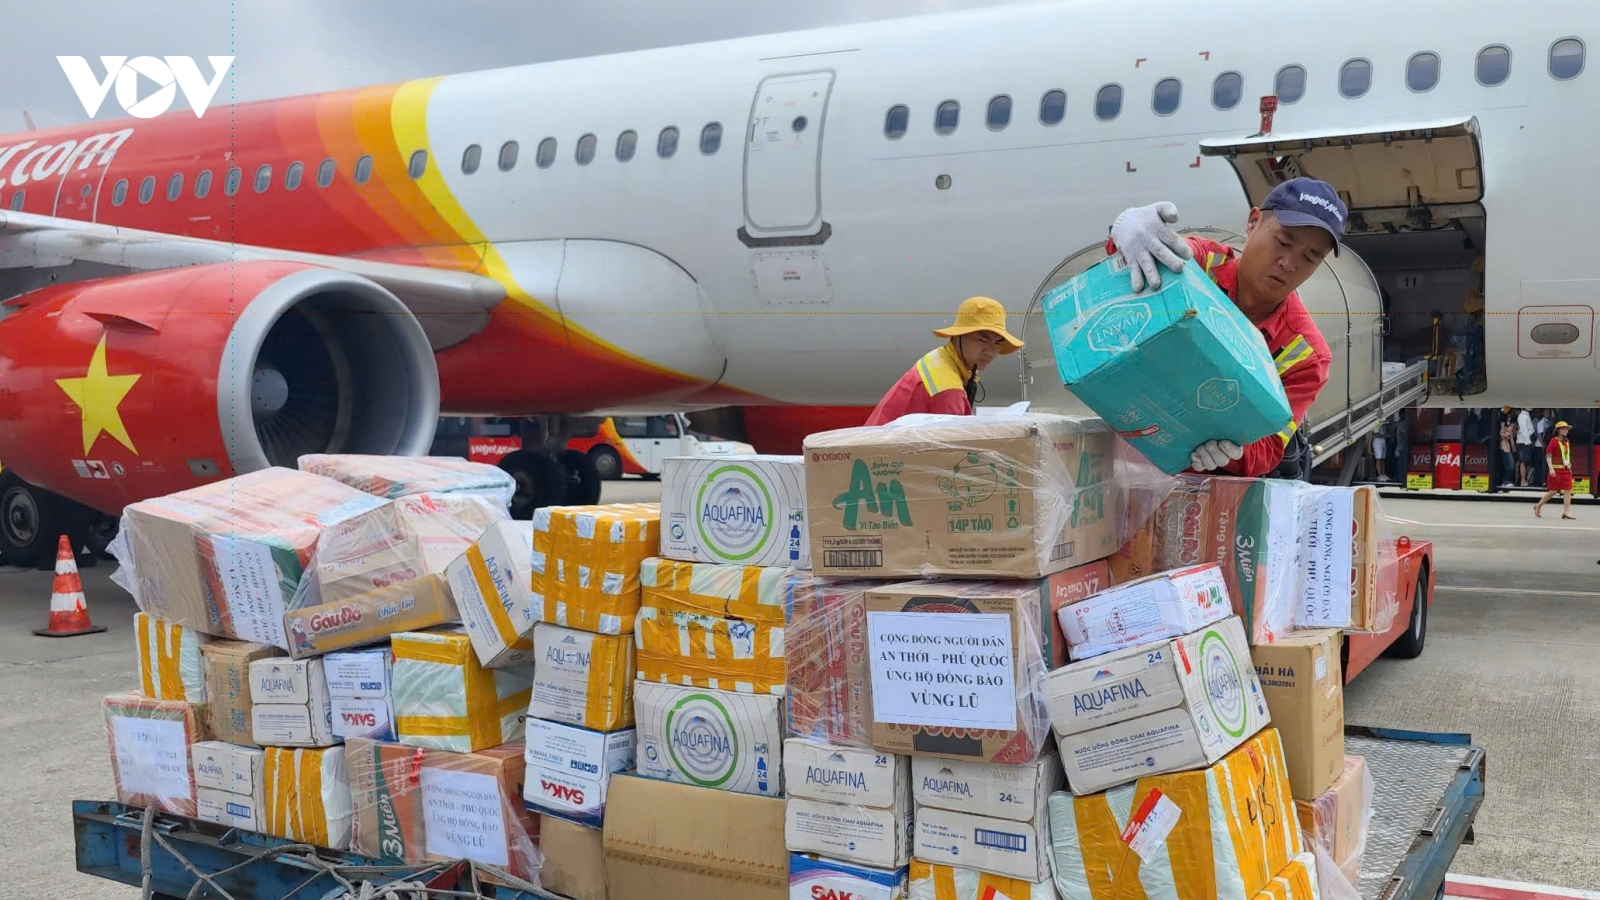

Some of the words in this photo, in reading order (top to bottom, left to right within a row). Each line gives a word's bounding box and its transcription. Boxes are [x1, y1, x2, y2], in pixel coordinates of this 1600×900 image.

[1403, 276, 1418, 288] 11
[1095, 310, 1146, 346] VIVANT
[819, 453, 851, 462] ORION
[832, 459, 913, 531] An
[702, 503, 766, 526] AQUAFINA
[948, 518, 970, 532] 14P
[1217, 511, 1230, 542] Tặng
[790, 539, 800, 547] 24
[1236, 534, 1255, 548] 3
[485, 556, 514, 613] AQUAFINA
[310, 607, 341, 630] Gấu
[341, 604, 362, 625] Đỏ
[880, 633, 909, 645] CỘNG
[911, 633, 941, 645] ĐỒNG
[944, 635, 979, 647] NGƯỜI
[982, 635, 1005, 647] DÂN
[546, 646, 591, 668] AQUINA
[880, 651, 895, 661] AN
[899, 650, 930, 663] THỚI
[942, 652, 967, 665] PHÚ
[970, 653, 1009, 668] QUỐC
[1147, 651, 1162, 663] 24
[915, 671, 933, 685] HỘ
[936, 671, 973, 685] ĐỒNG
[976, 673, 1003, 686] BÀO
[1278, 666, 1295, 677] HÀ
[261, 678, 295, 693] AQUAFINA
[911, 690, 954, 707] VÙNG
[958, 693, 979, 708] LŨ
[1073, 677, 1151, 717] AQUAFINA
[341, 713, 376, 727] SAKA
[1130, 732, 1146, 741] CHAI
[1146, 723, 1180, 737] AQUAFINA
[673, 729, 734, 756] AQUAFINA
[875, 755, 887, 765] 24
[198, 763, 225, 777] AQUAFINA
[757, 771, 767, 779] 24
[805, 765, 869, 792] AQUAFINA
[541, 779, 585, 805] SAKA
[923, 776, 973, 798] AQUAFINA
[999, 792, 1012, 803] 24
[856, 820, 884, 828] AQUAFINA
[382, 838, 403, 858] 3
